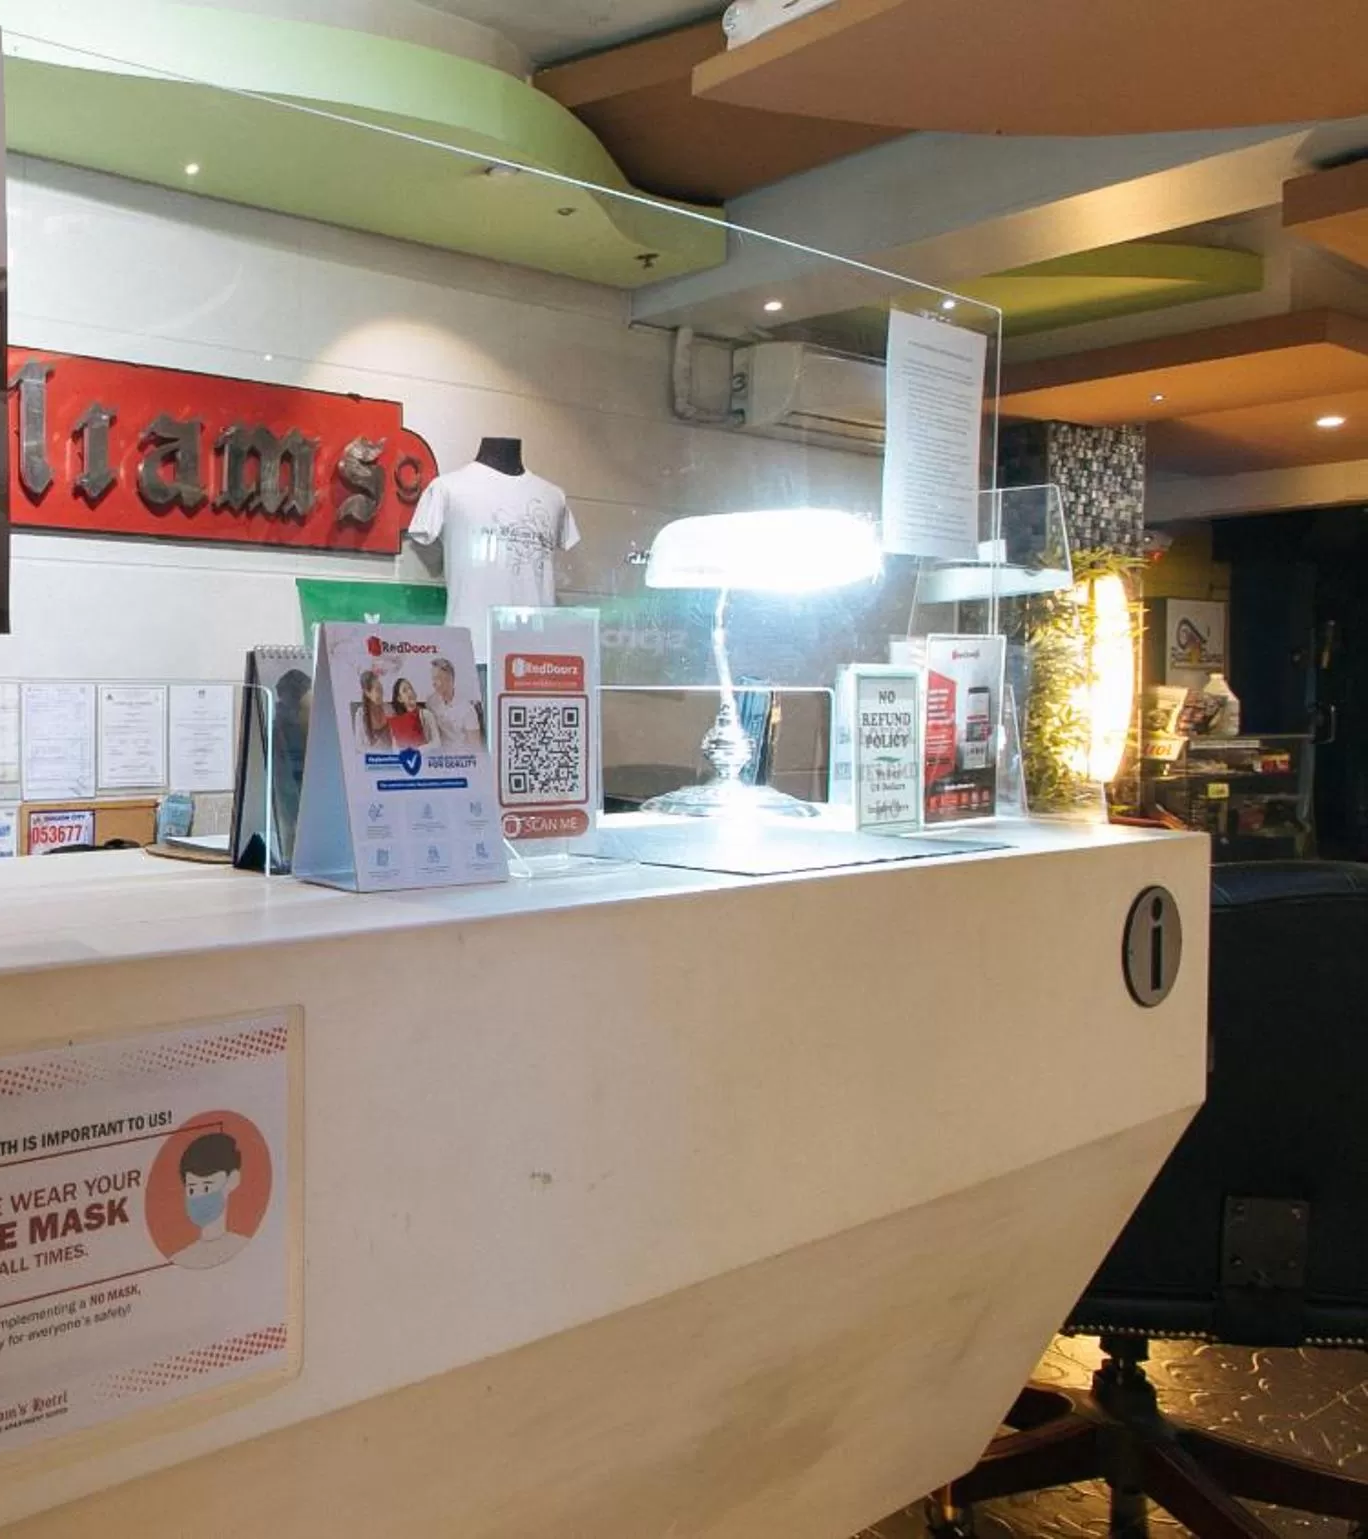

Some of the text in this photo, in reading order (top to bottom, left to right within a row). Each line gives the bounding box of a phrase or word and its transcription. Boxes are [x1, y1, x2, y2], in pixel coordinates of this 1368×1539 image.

[382, 641, 438, 654] RedDoorz
[878, 690, 896, 704] NO
[862, 712, 911, 726] REFUND
[865, 734, 910, 749] POLICY
[32, 825, 83, 844] 053677
[524, 815, 578, 834] SCAN ME
[22, 1133, 38, 1153] IS
[41, 1120, 126, 1149] IMPORTANT
[126, 1115, 146, 1133] TO
[147, 1110, 173, 1130] US!
[10, 1183, 78, 1215] WEAR
[83, 1169, 143, 1198] YOUR
[28, 1196, 131, 1245] MASK
[34, 1243, 89, 1269] TIMES.
[78, 1299, 87, 1310] a
[89, 1290, 105, 1307] NO
[8, 1329, 25, 1346] for
[27, 1314, 92, 1344] everyone's
[93, 1302, 132, 1327] safety!
[32, 1390, 69, 1413] Hotel
